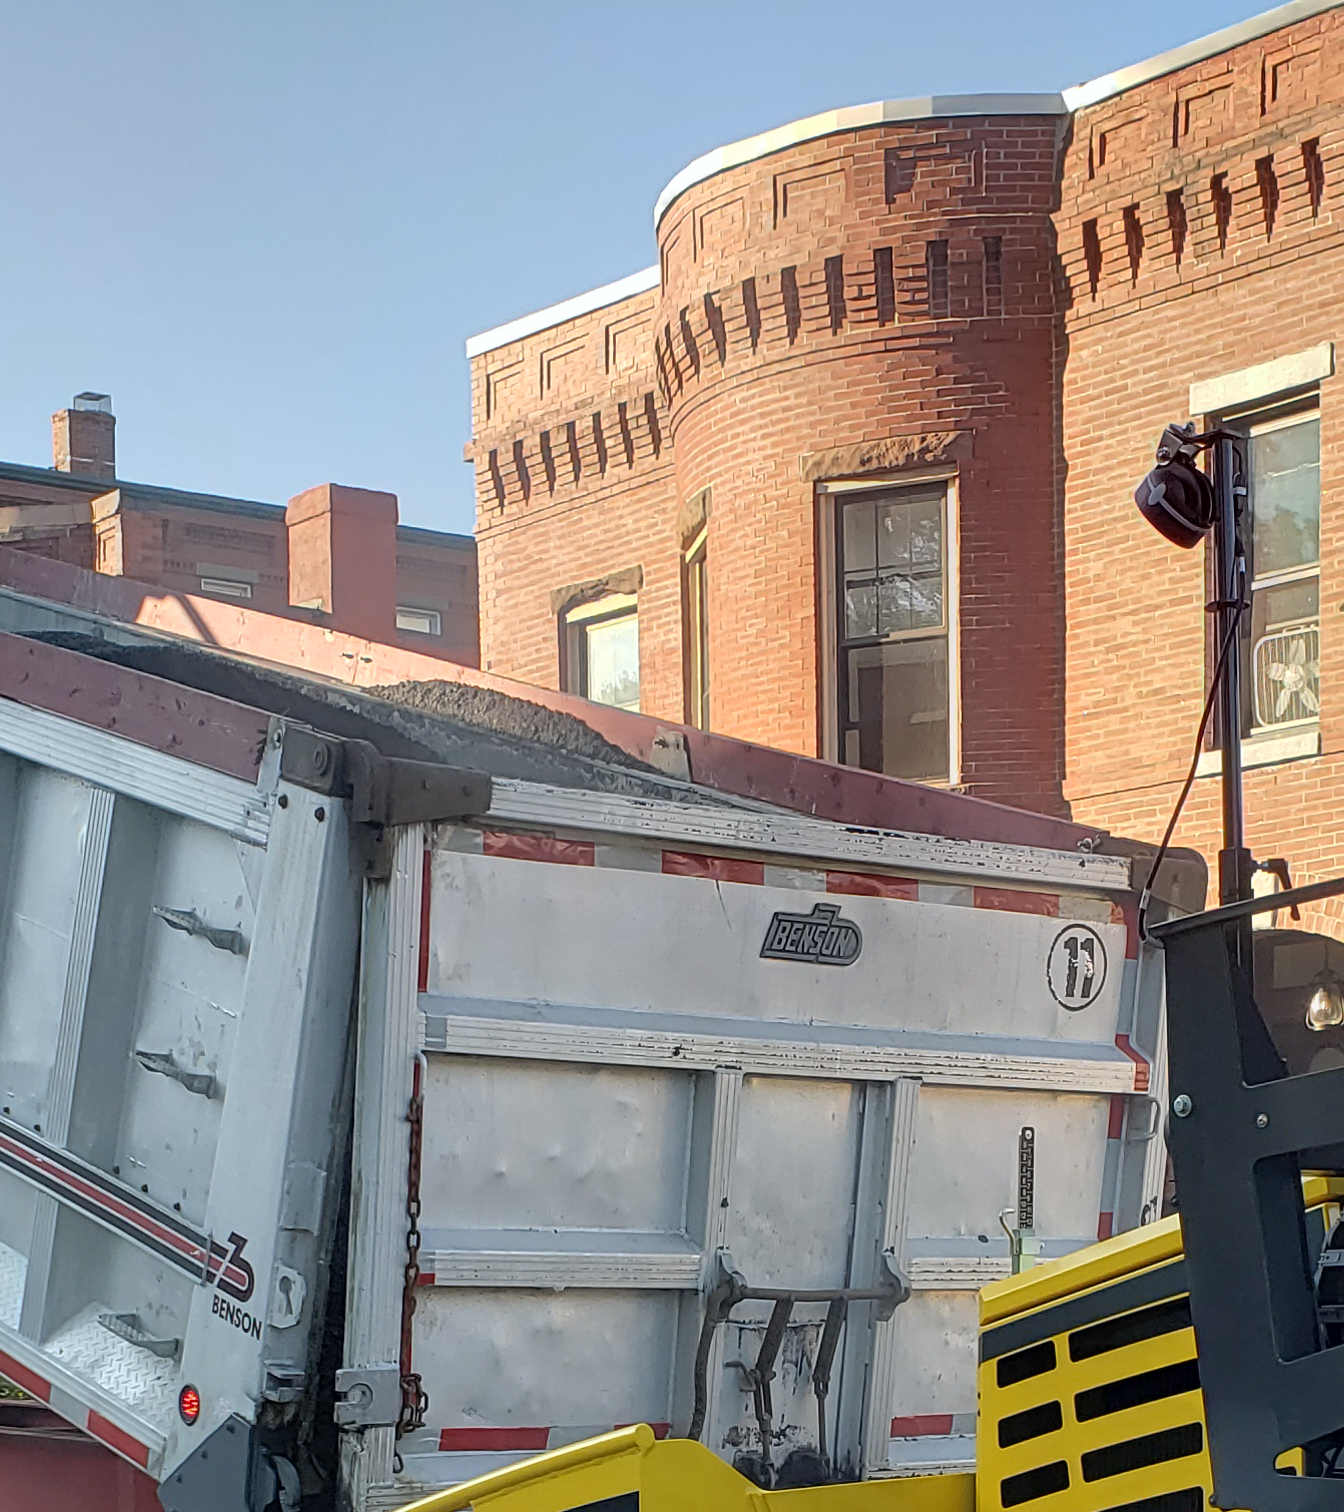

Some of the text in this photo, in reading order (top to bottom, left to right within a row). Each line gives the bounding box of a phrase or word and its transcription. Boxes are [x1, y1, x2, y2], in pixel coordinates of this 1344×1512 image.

[770, 920, 853, 957] BENSON
[1063, 936, 1095, 998] 11
[211, 1293, 263, 1341] BENSON
